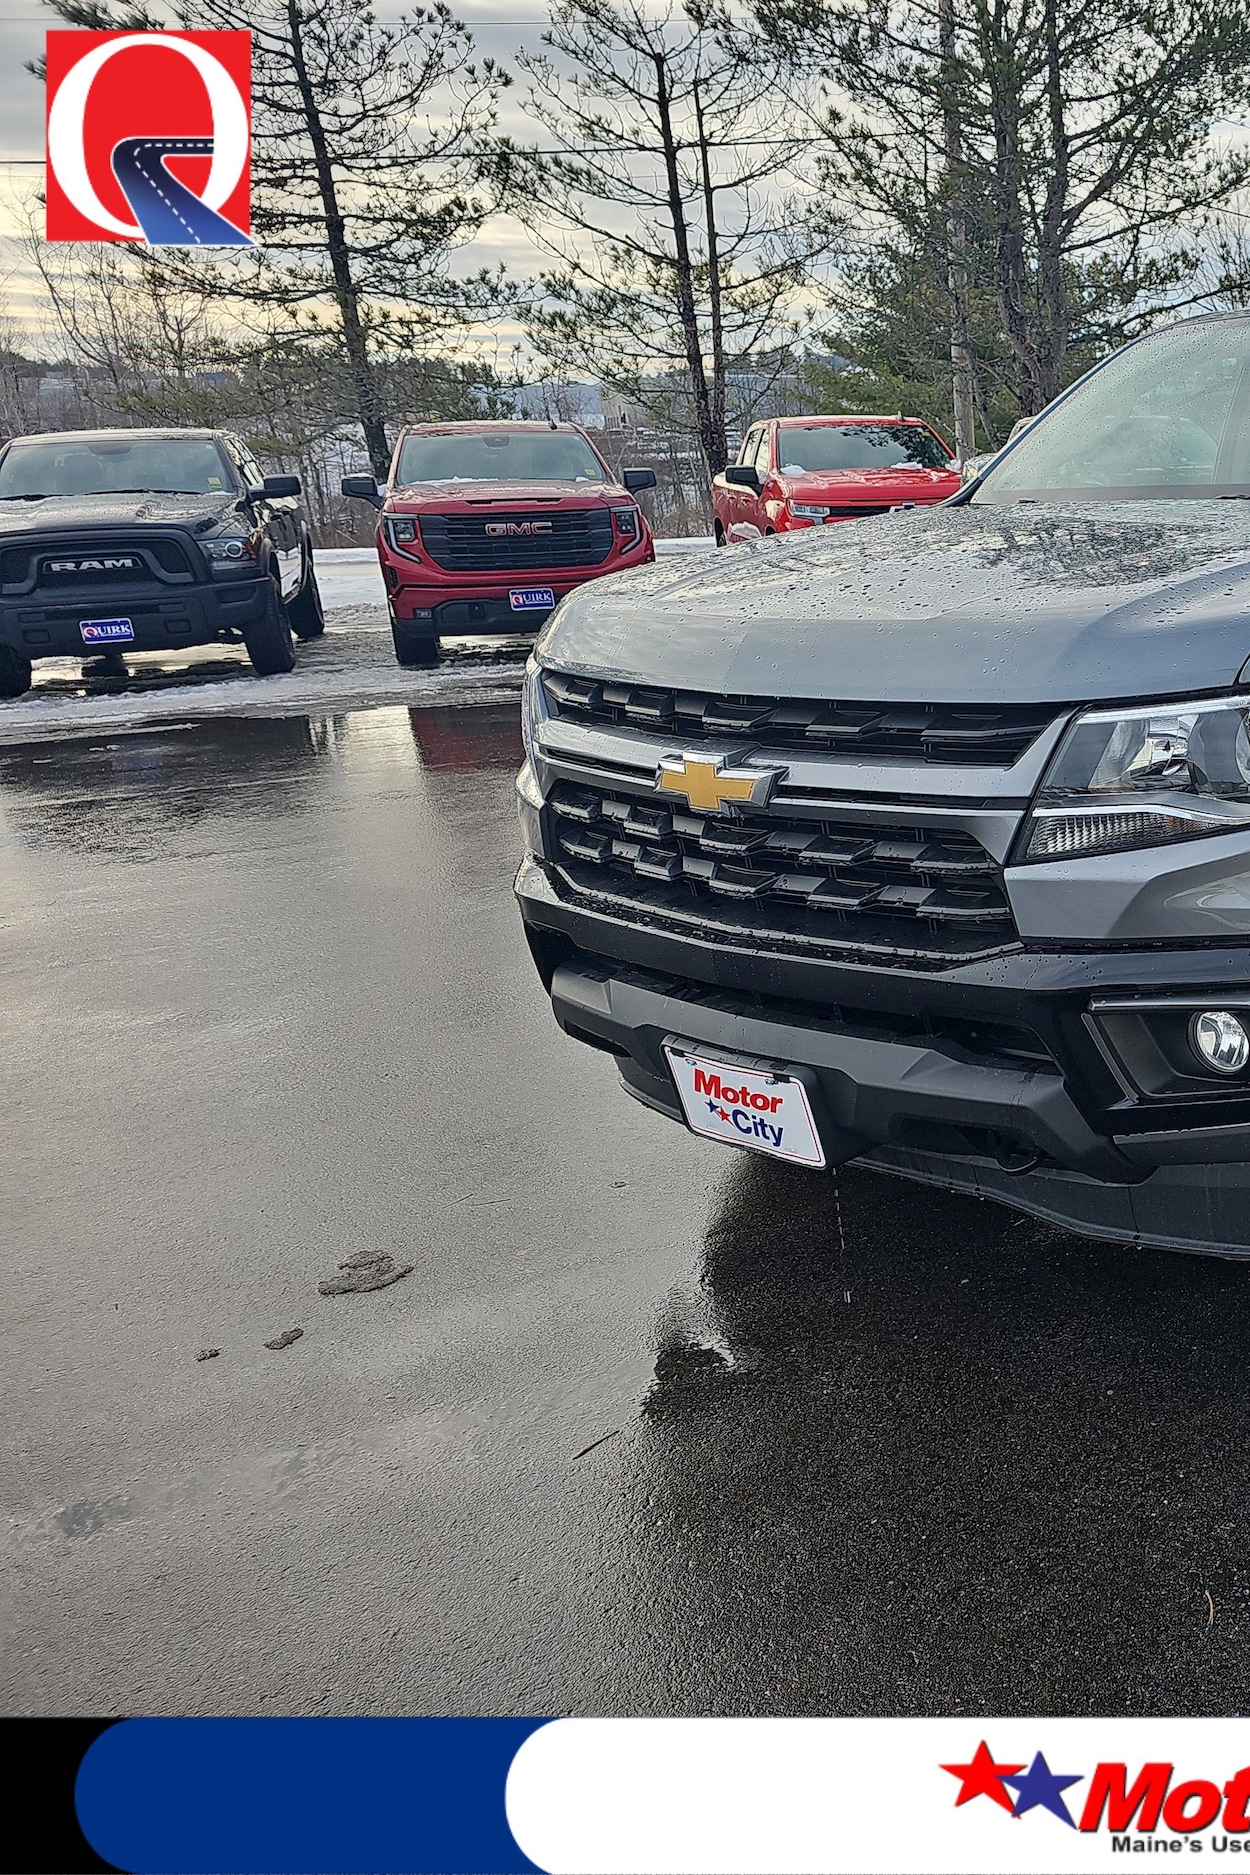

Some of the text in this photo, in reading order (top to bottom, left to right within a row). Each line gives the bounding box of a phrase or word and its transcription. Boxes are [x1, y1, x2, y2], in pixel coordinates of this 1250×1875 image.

[485, 521, 553, 537] GMC
[51, 559, 133, 571] RAM
[512, 593, 553, 606] QUIRK
[83, 624, 132, 638] QUIRK
[694, 1068, 783, 1113] Motor
[732, 1109, 784, 1147] City
